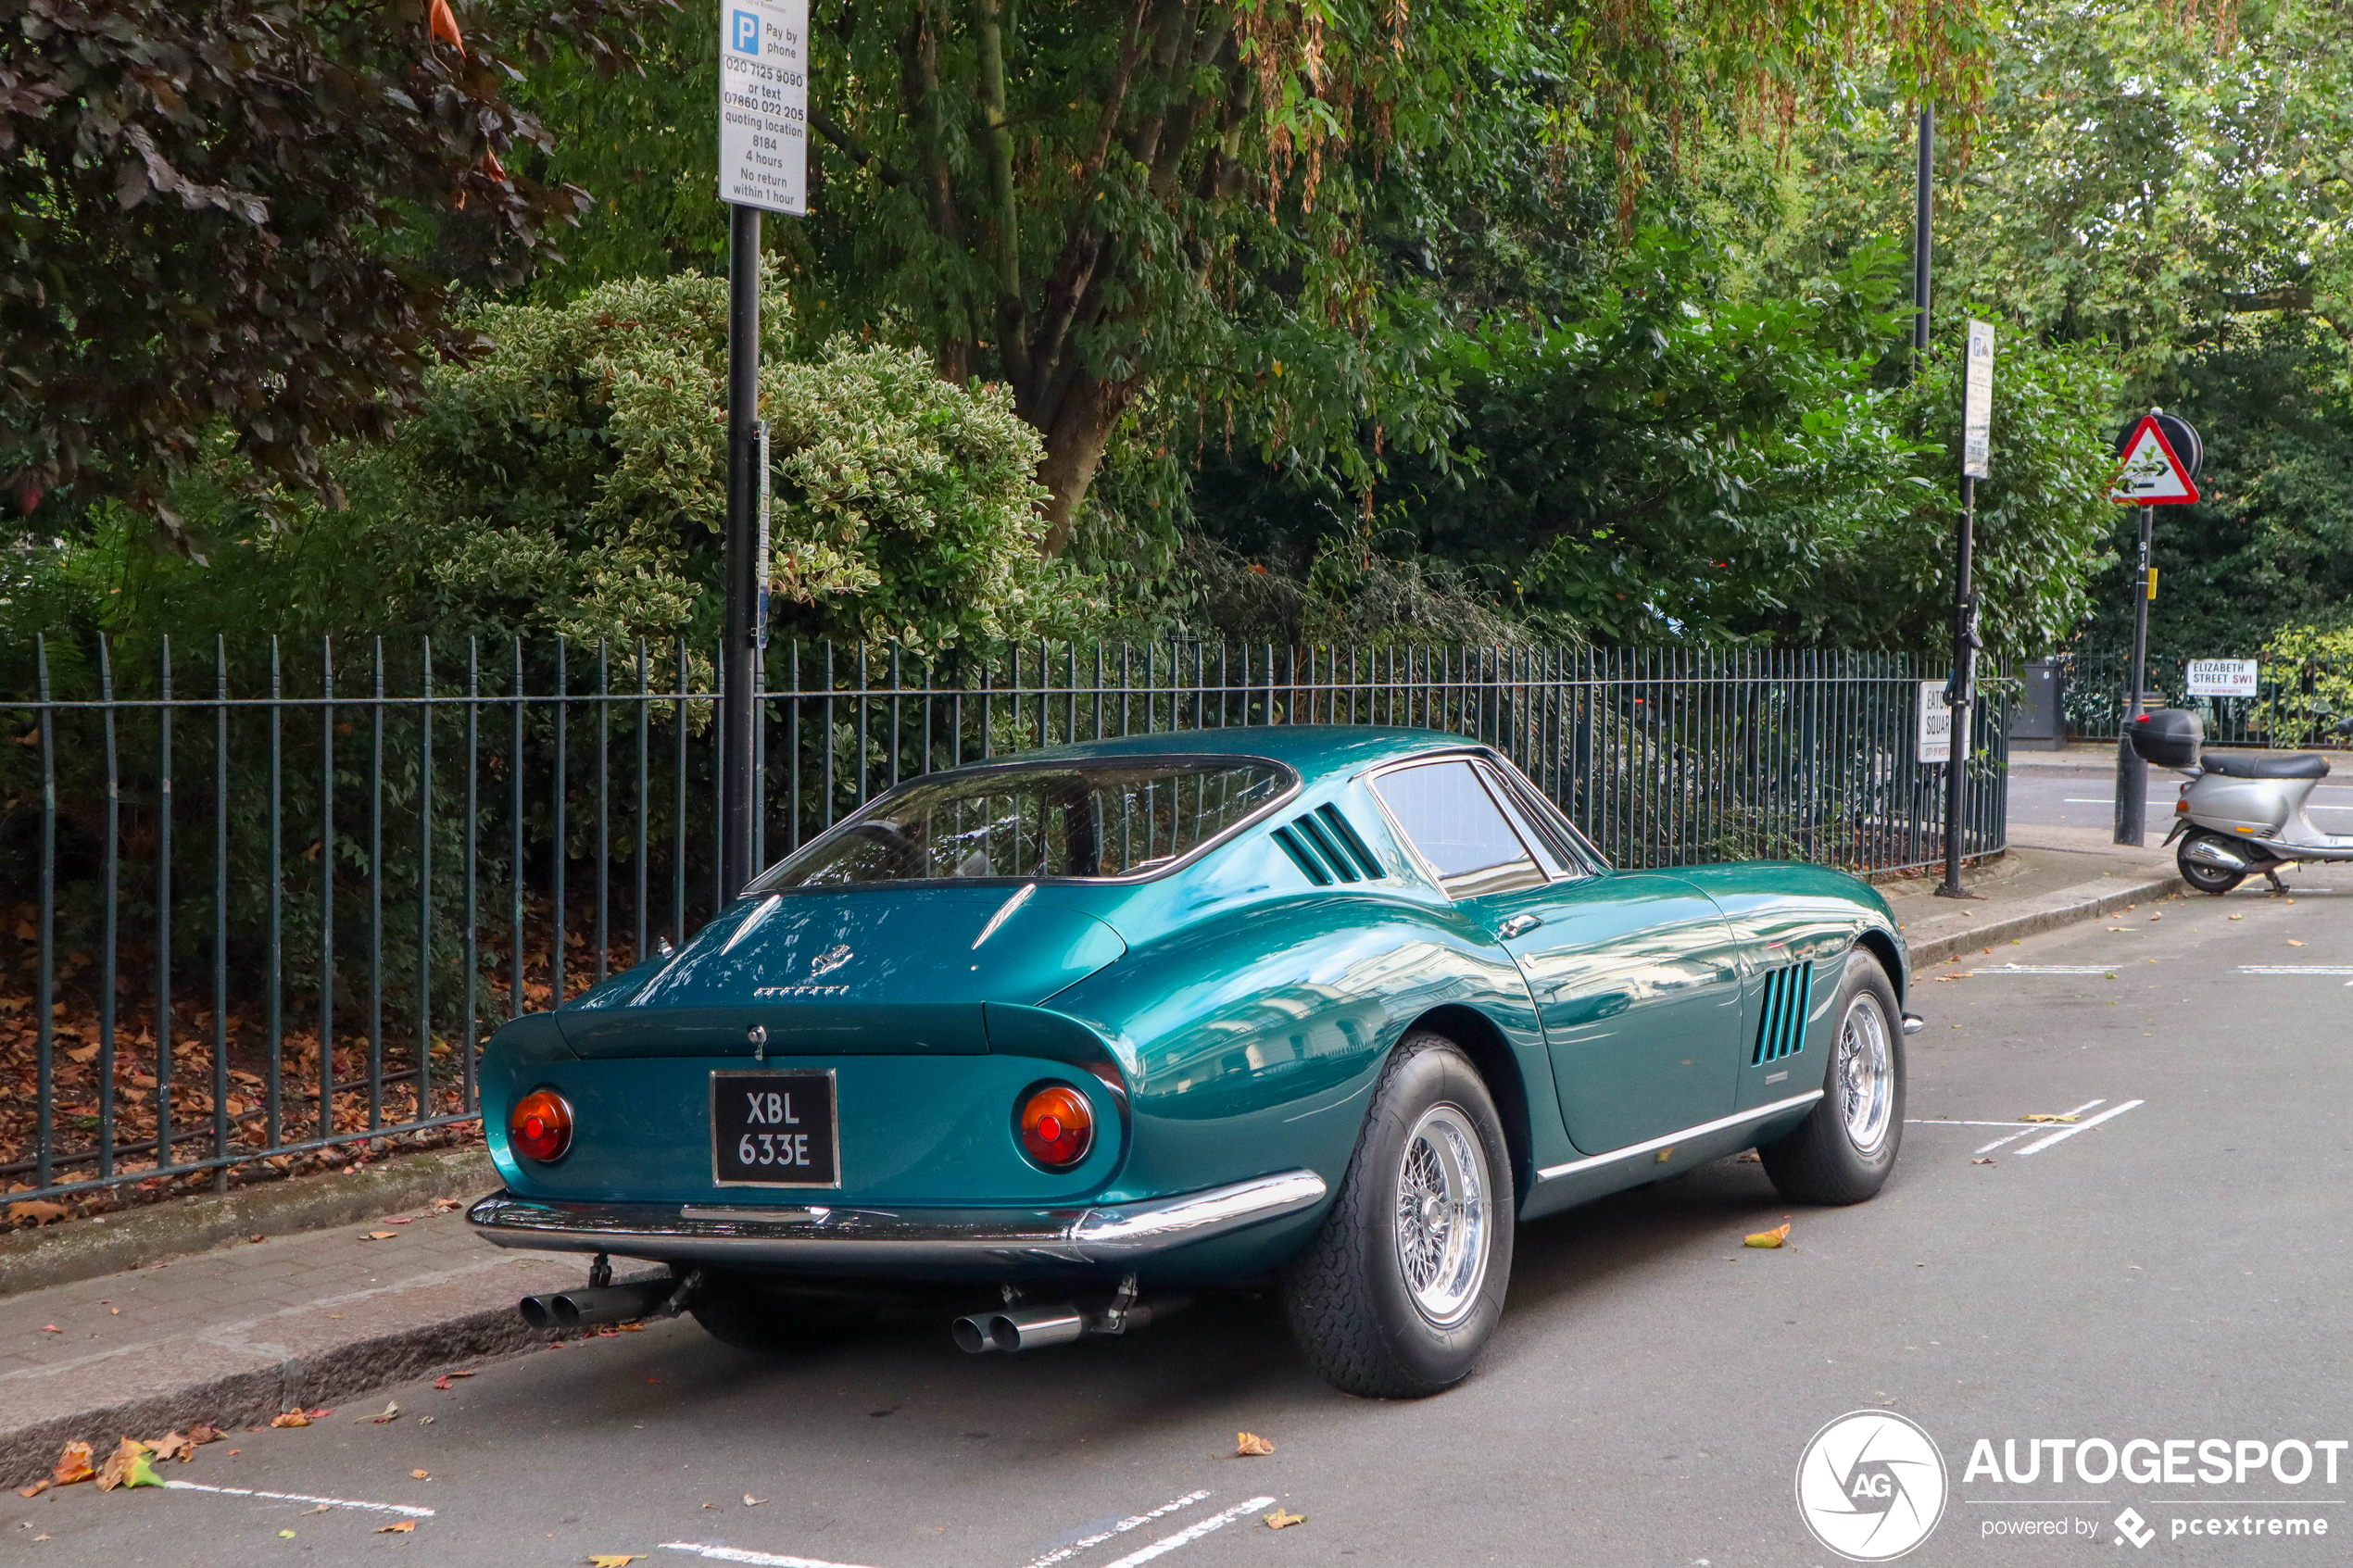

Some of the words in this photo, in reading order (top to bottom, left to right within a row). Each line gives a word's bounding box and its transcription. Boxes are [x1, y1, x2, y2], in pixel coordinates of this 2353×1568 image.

[739, 16, 755, 48] P
[766, 22, 783, 41] Pay
[786, 28, 798, 44] by
[767, 42, 796, 58] phone
[726, 56, 747, 73] 020
[750, 63, 773, 80] 7125
[776, 69, 803, 87] 9090
[749, 83, 758, 94] or
[761, 84, 781, 100] text
[724, 91, 758, 110] 07860
[761, 100, 781, 116] 022
[784, 106, 804, 121] 205
[725, 111, 761, 131] quoting
[765, 118, 802, 138] location
[753, 134, 776, 151] 8184
[746, 149, 752, 161] 4
[756, 151, 783, 169] hours
[740, 167, 754, 181] No
[758, 173, 787, 188] return
[733, 183, 762, 199] within
[766, 189, 770, 200] 1
[774, 190, 794, 205] hour
[2194, 662, 2245, 672] ELIZABETH
[2194, 673, 2228, 684] STREET
[2233, 674, 2252, 684] SW1
[1927, 690, 1949, 710] EATO
[1926, 714, 1950, 735] SQUAR
[746, 1092, 799, 1124] XBL
[738, 1133, 810, 1166] 633E
